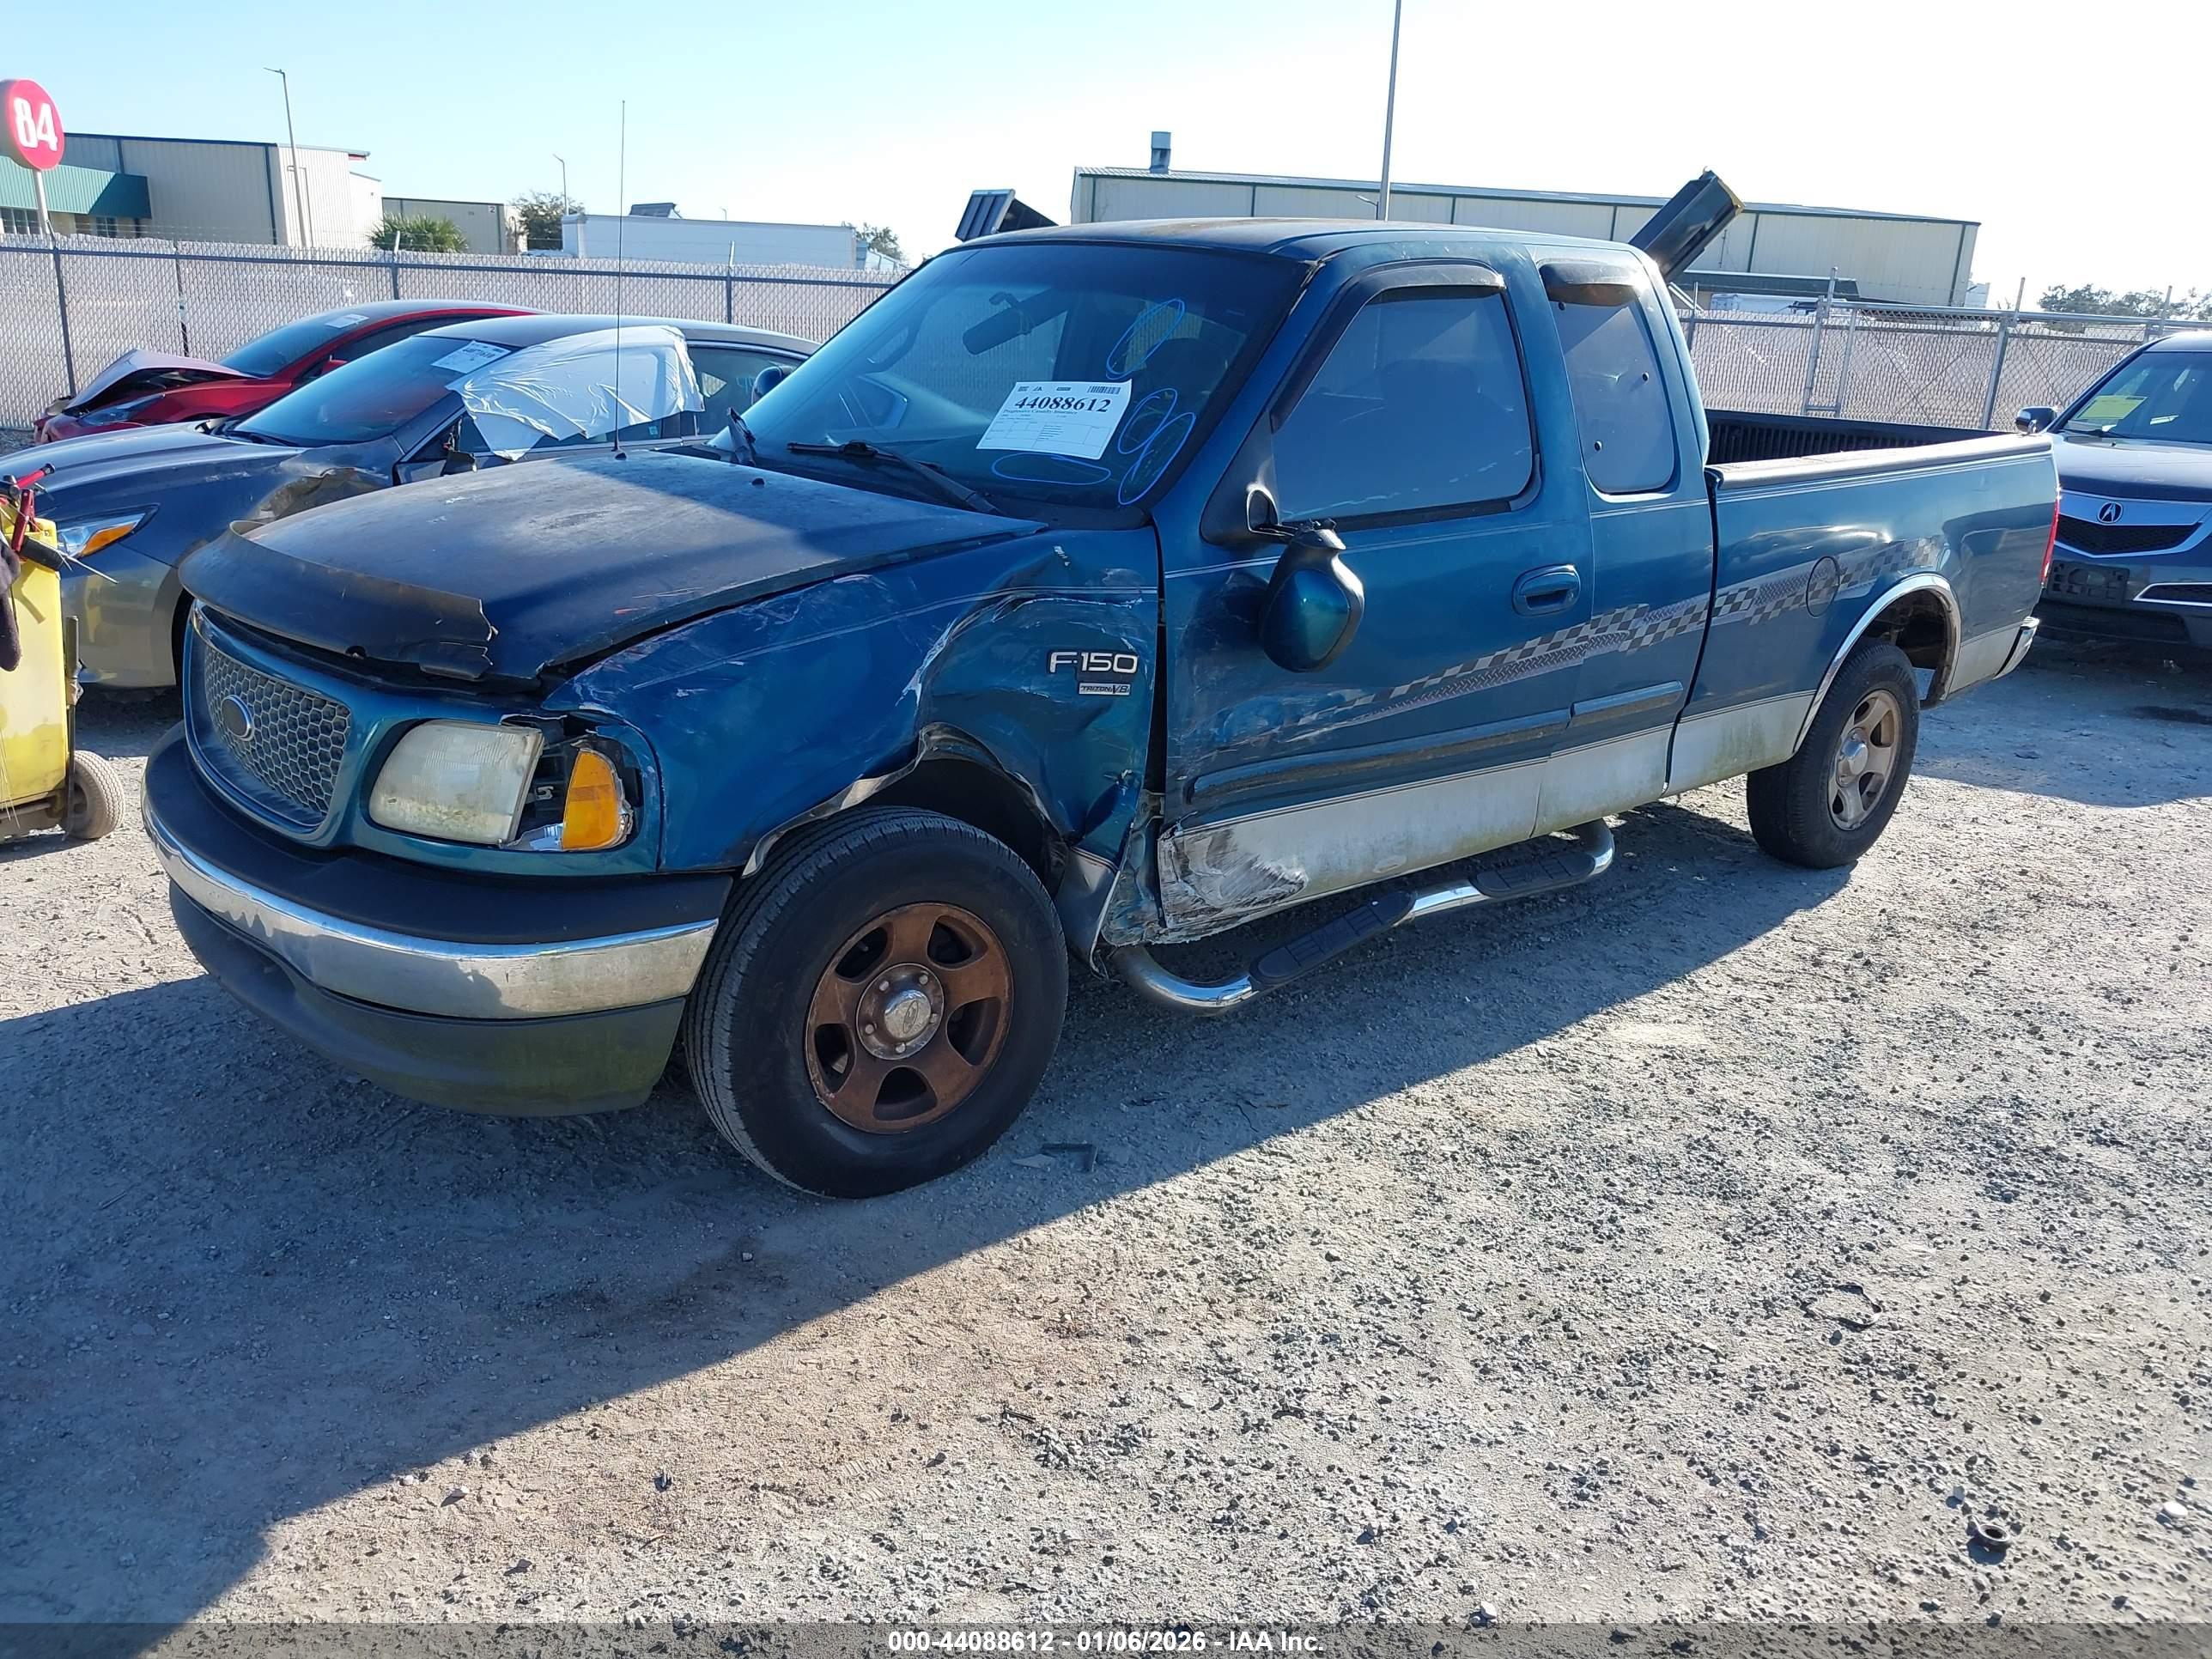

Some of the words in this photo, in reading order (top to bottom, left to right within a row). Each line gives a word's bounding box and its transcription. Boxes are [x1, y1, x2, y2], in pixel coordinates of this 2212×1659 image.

[13, 96, 58, 152] 84
[1015, 396, 1111, 413] 44088612
[1113, 684, 1128, 694] V8
